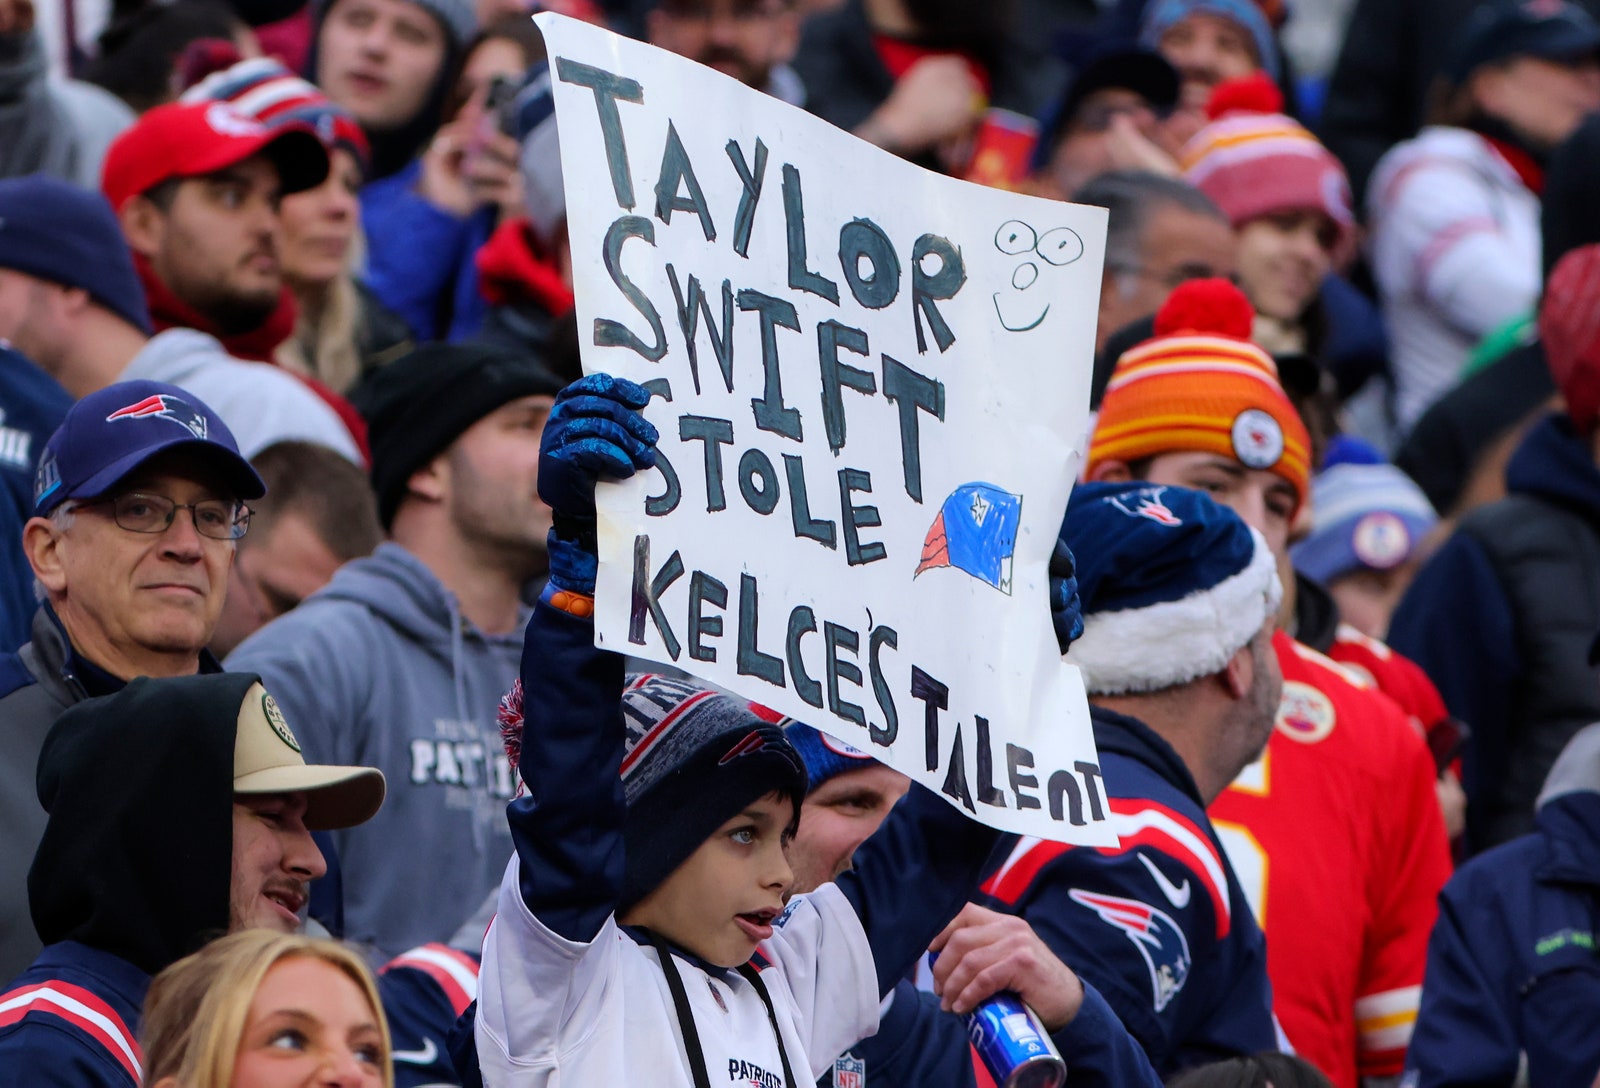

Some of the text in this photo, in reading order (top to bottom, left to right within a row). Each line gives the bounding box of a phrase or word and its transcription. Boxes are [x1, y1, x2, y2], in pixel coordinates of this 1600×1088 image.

[555, 56, 967, 354] TAYLOR
[594, 215, 946, 504] SWIFT
[628, 534, 898, 747] KELCE'S
[839, 1071, 861, 1088] NFL
